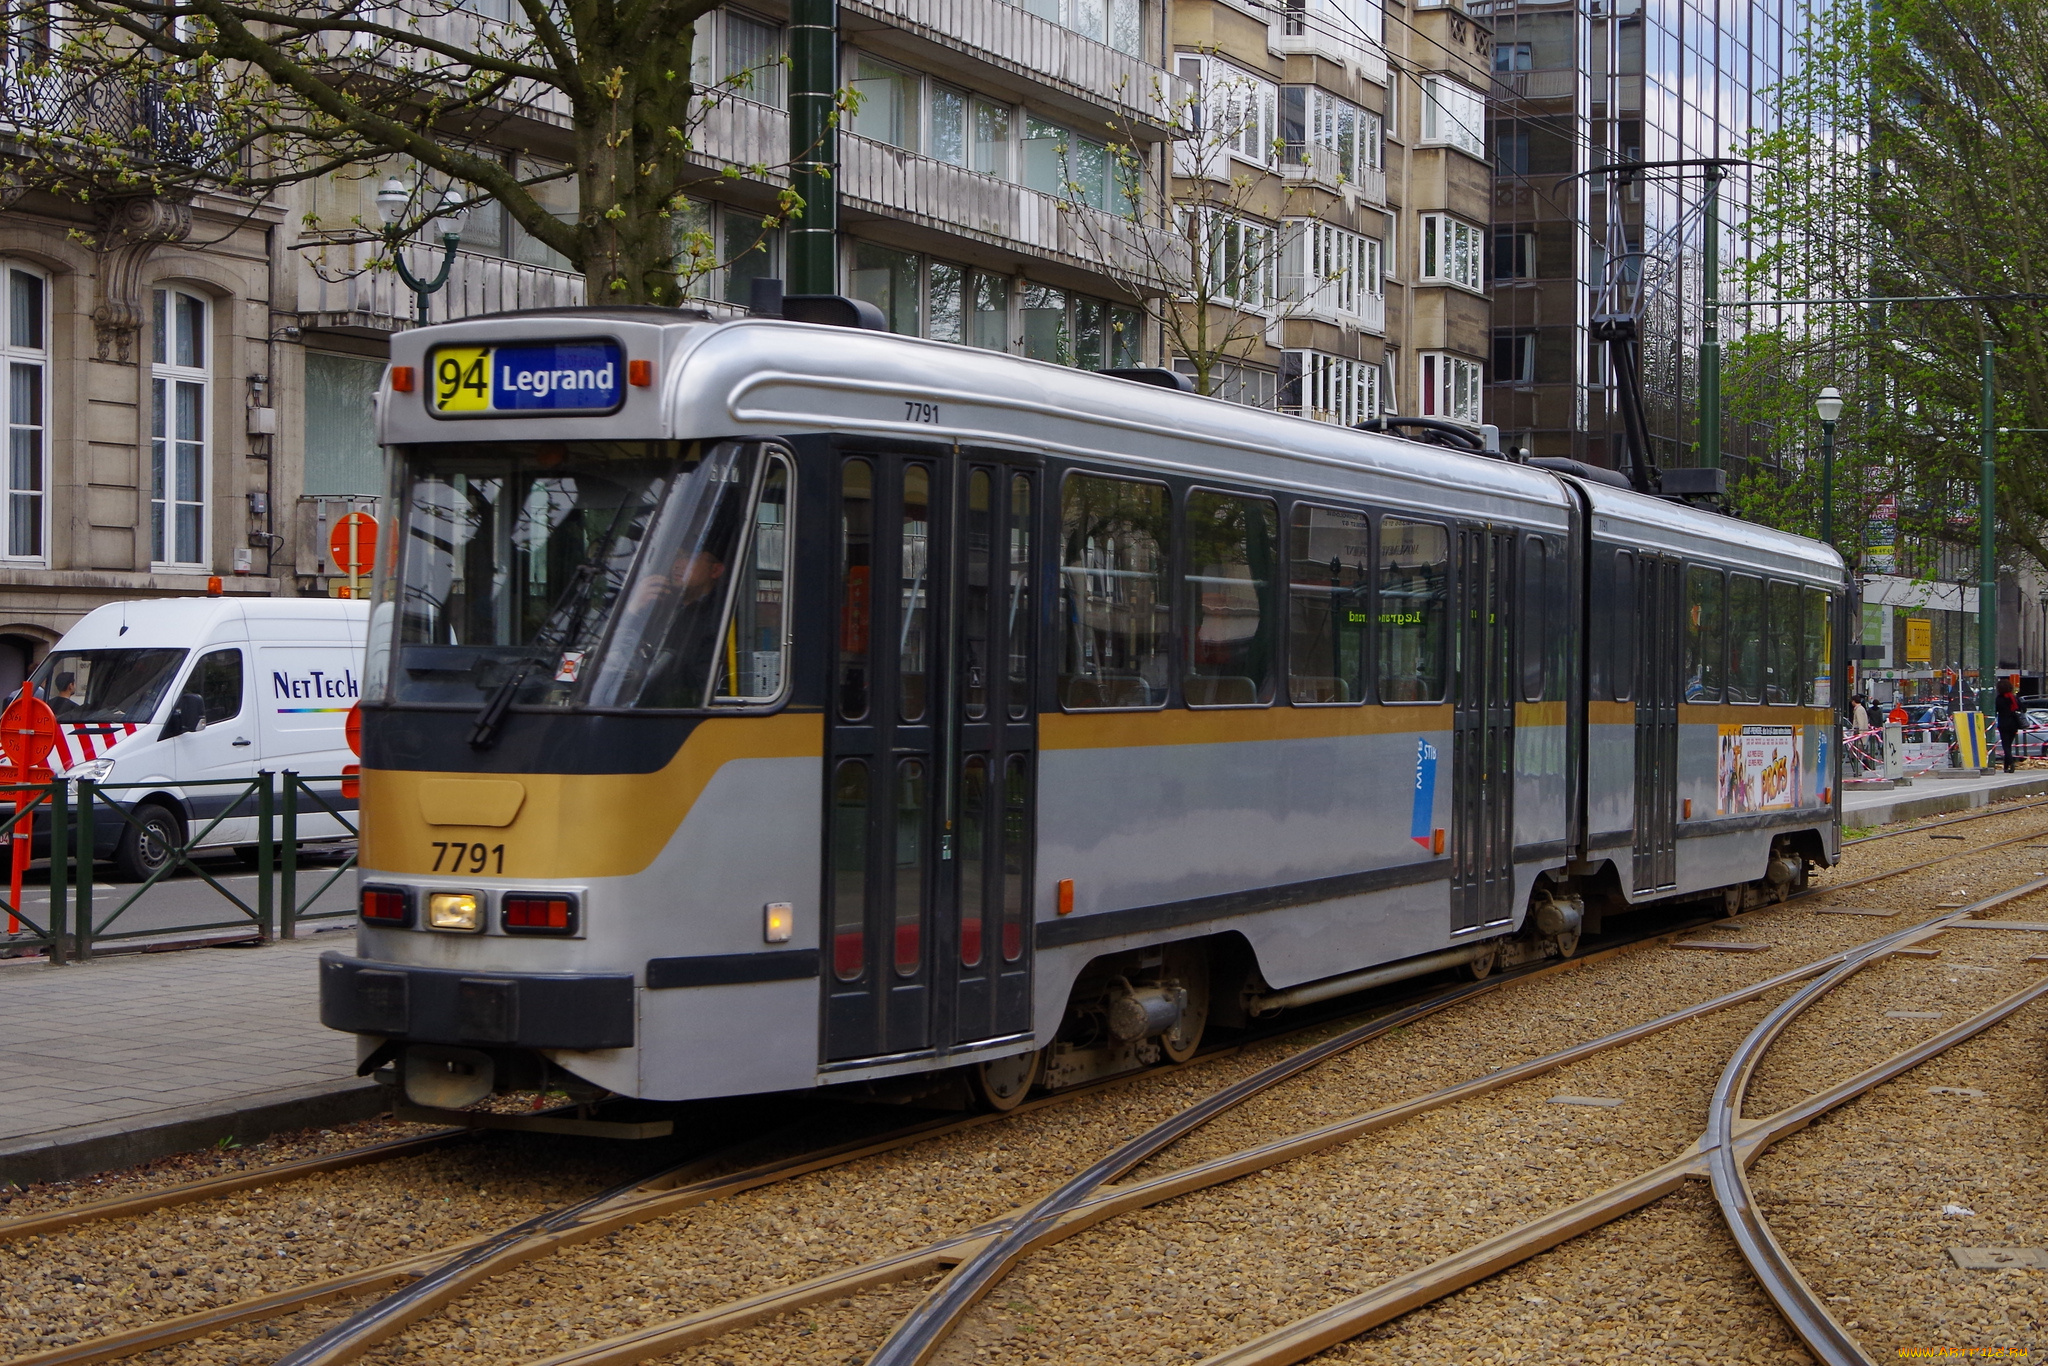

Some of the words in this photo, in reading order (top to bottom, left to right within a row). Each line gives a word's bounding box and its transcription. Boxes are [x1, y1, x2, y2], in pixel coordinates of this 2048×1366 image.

[439, 358, 487, 399] 94
[503, 362, 613, 397] Legrand
[905, 401, 939, 424] 7791
[1424, 744, 1437, 760] STIB
[432, 842, 505, 875] 7791
